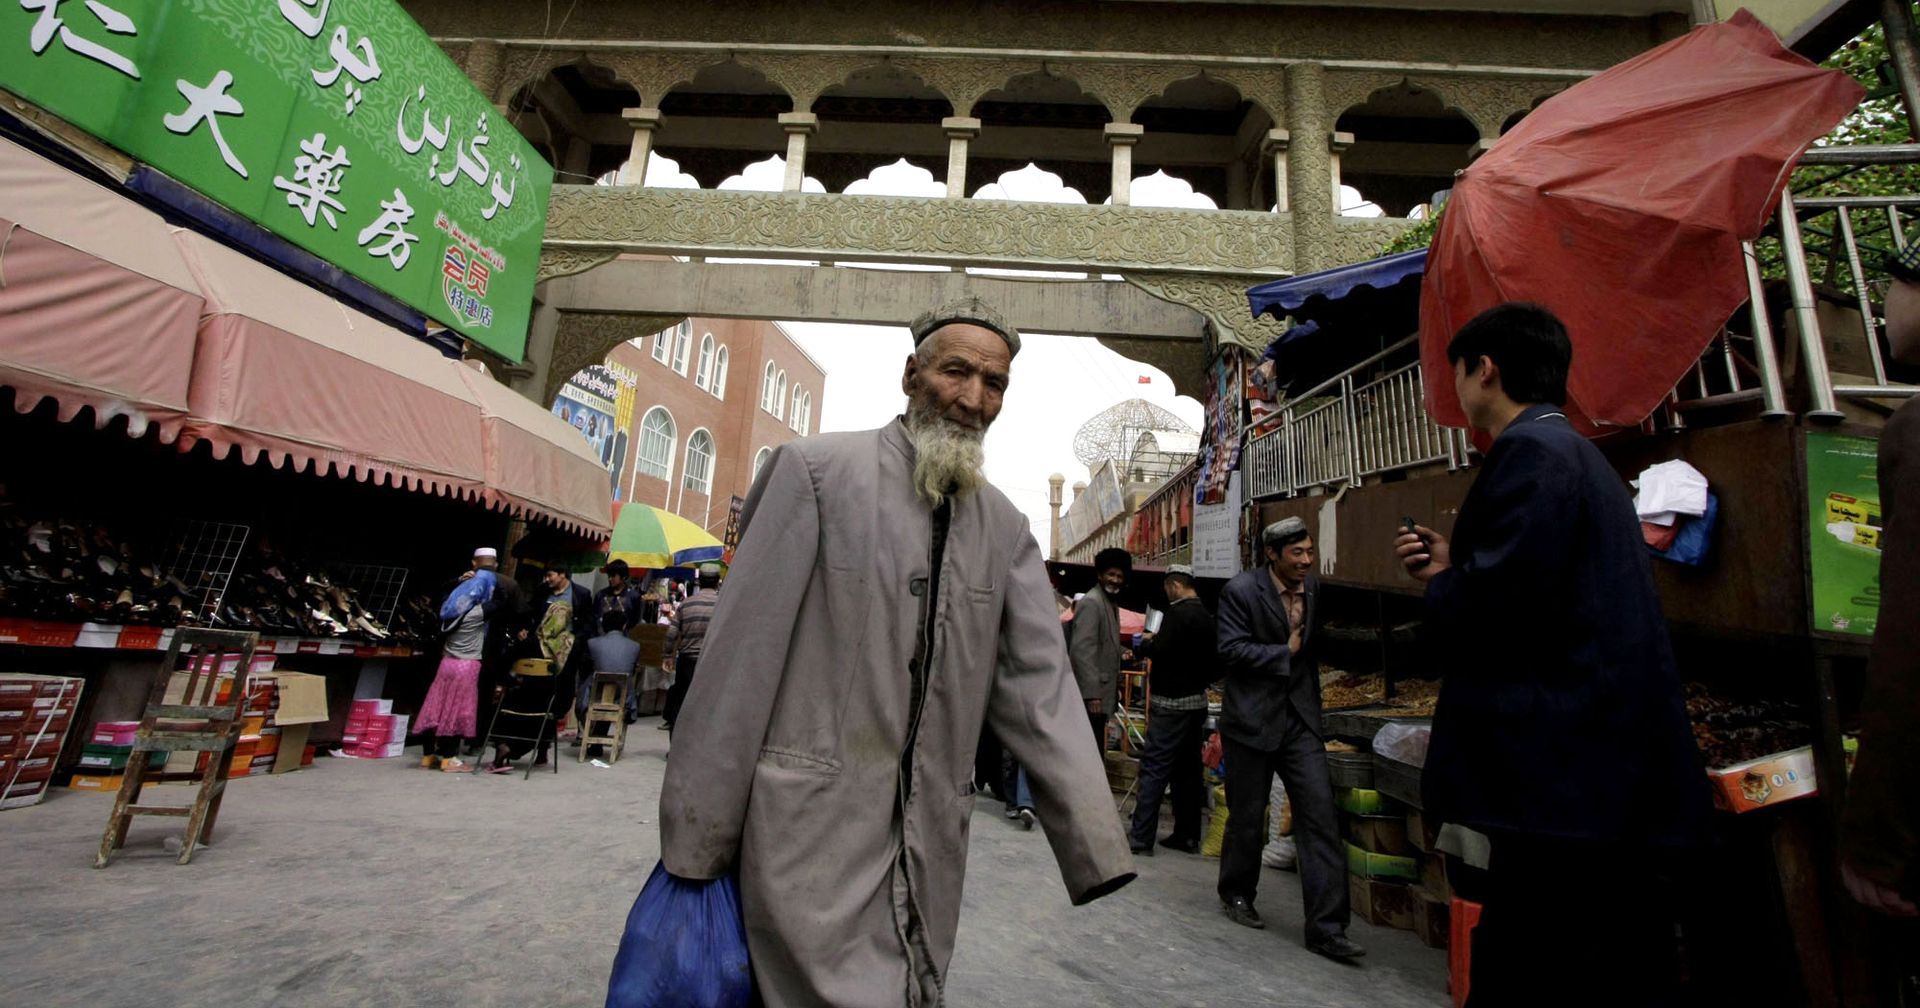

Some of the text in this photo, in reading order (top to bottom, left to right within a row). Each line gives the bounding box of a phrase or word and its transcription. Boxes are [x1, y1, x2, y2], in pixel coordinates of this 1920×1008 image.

[442, 245, 490, 298] 会员
[450, 286, 494, 328] 特惠店
